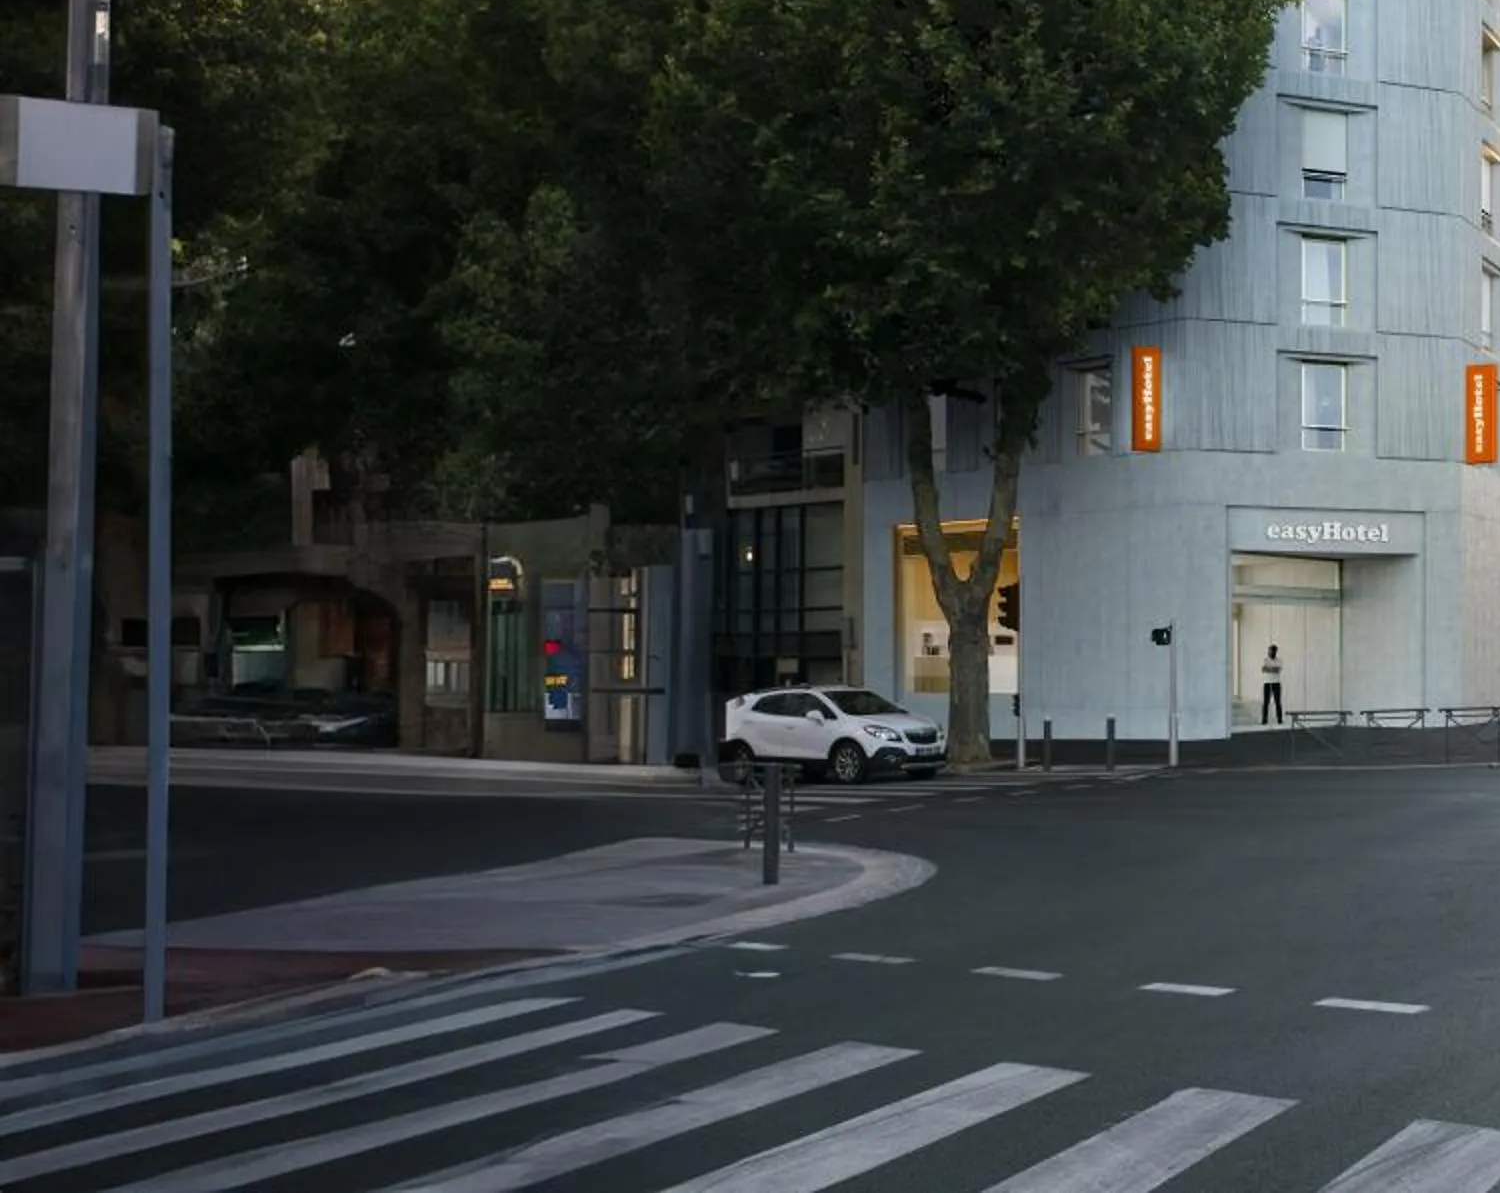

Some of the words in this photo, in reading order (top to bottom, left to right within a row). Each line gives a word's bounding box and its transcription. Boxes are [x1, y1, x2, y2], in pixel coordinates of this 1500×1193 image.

[1142, 355, 1154, 441] easyHotel
[1473, 373, 1485, 454] easyHotel
[1266, 521, 1390, 544] easyHotel
